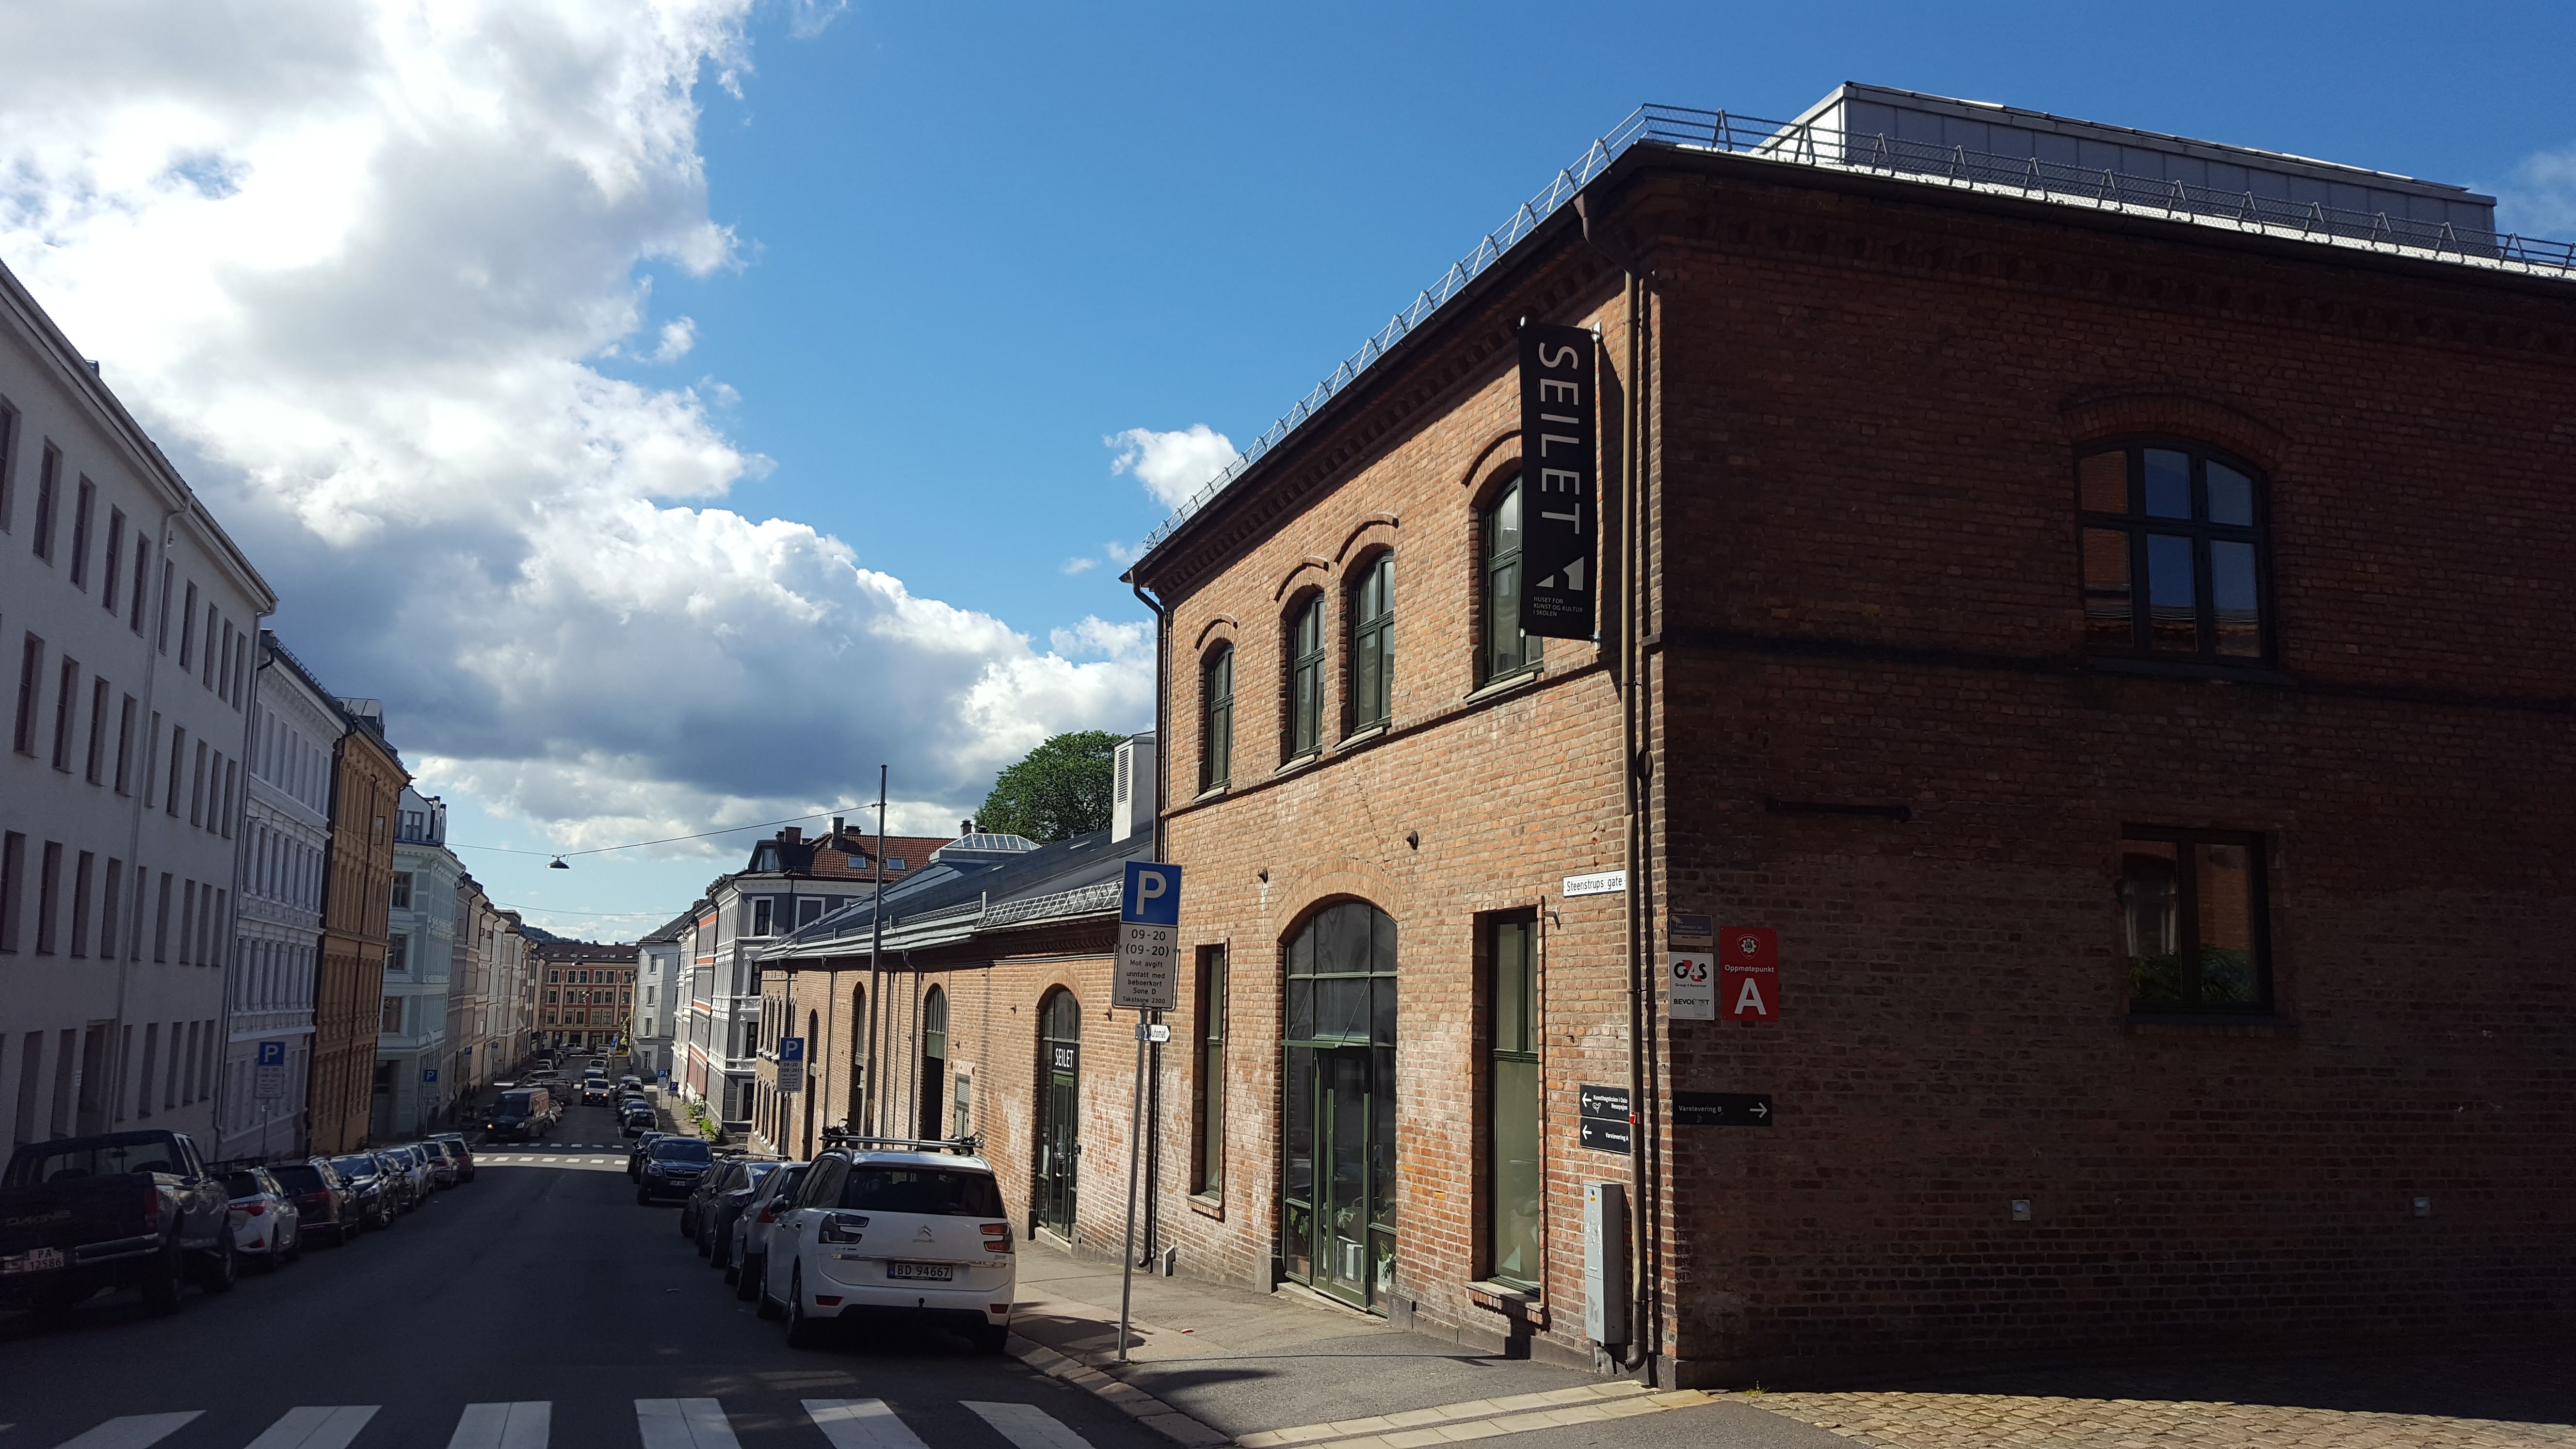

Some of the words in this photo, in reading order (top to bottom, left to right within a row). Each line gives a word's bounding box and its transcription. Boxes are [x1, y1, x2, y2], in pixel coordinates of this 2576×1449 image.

[1538, 342, 1579, 534] SEILET
[1136, 870, 1166, 915] P
[1567, 879, 1604, 891] Steenstrups
[1608, 876, 1622, 889] gate
[1674, 959, 1707, 982] G4S
[1724, 964, 1775, 973] Oppmøtepunkt
[1734, 978, 1767, 1015] A
[264, 1045, 278, 1063] P
[786, 1040, 798, 1058] P
[1055, 1047, 1074, 1068] SEILET
[427, 1071, 435, 1080] P
[1678, 1105, 1716, 1113] Varelevering
[898, 1265, 912, 1275] BD
[917, 1266, 950, 1277] 94667
